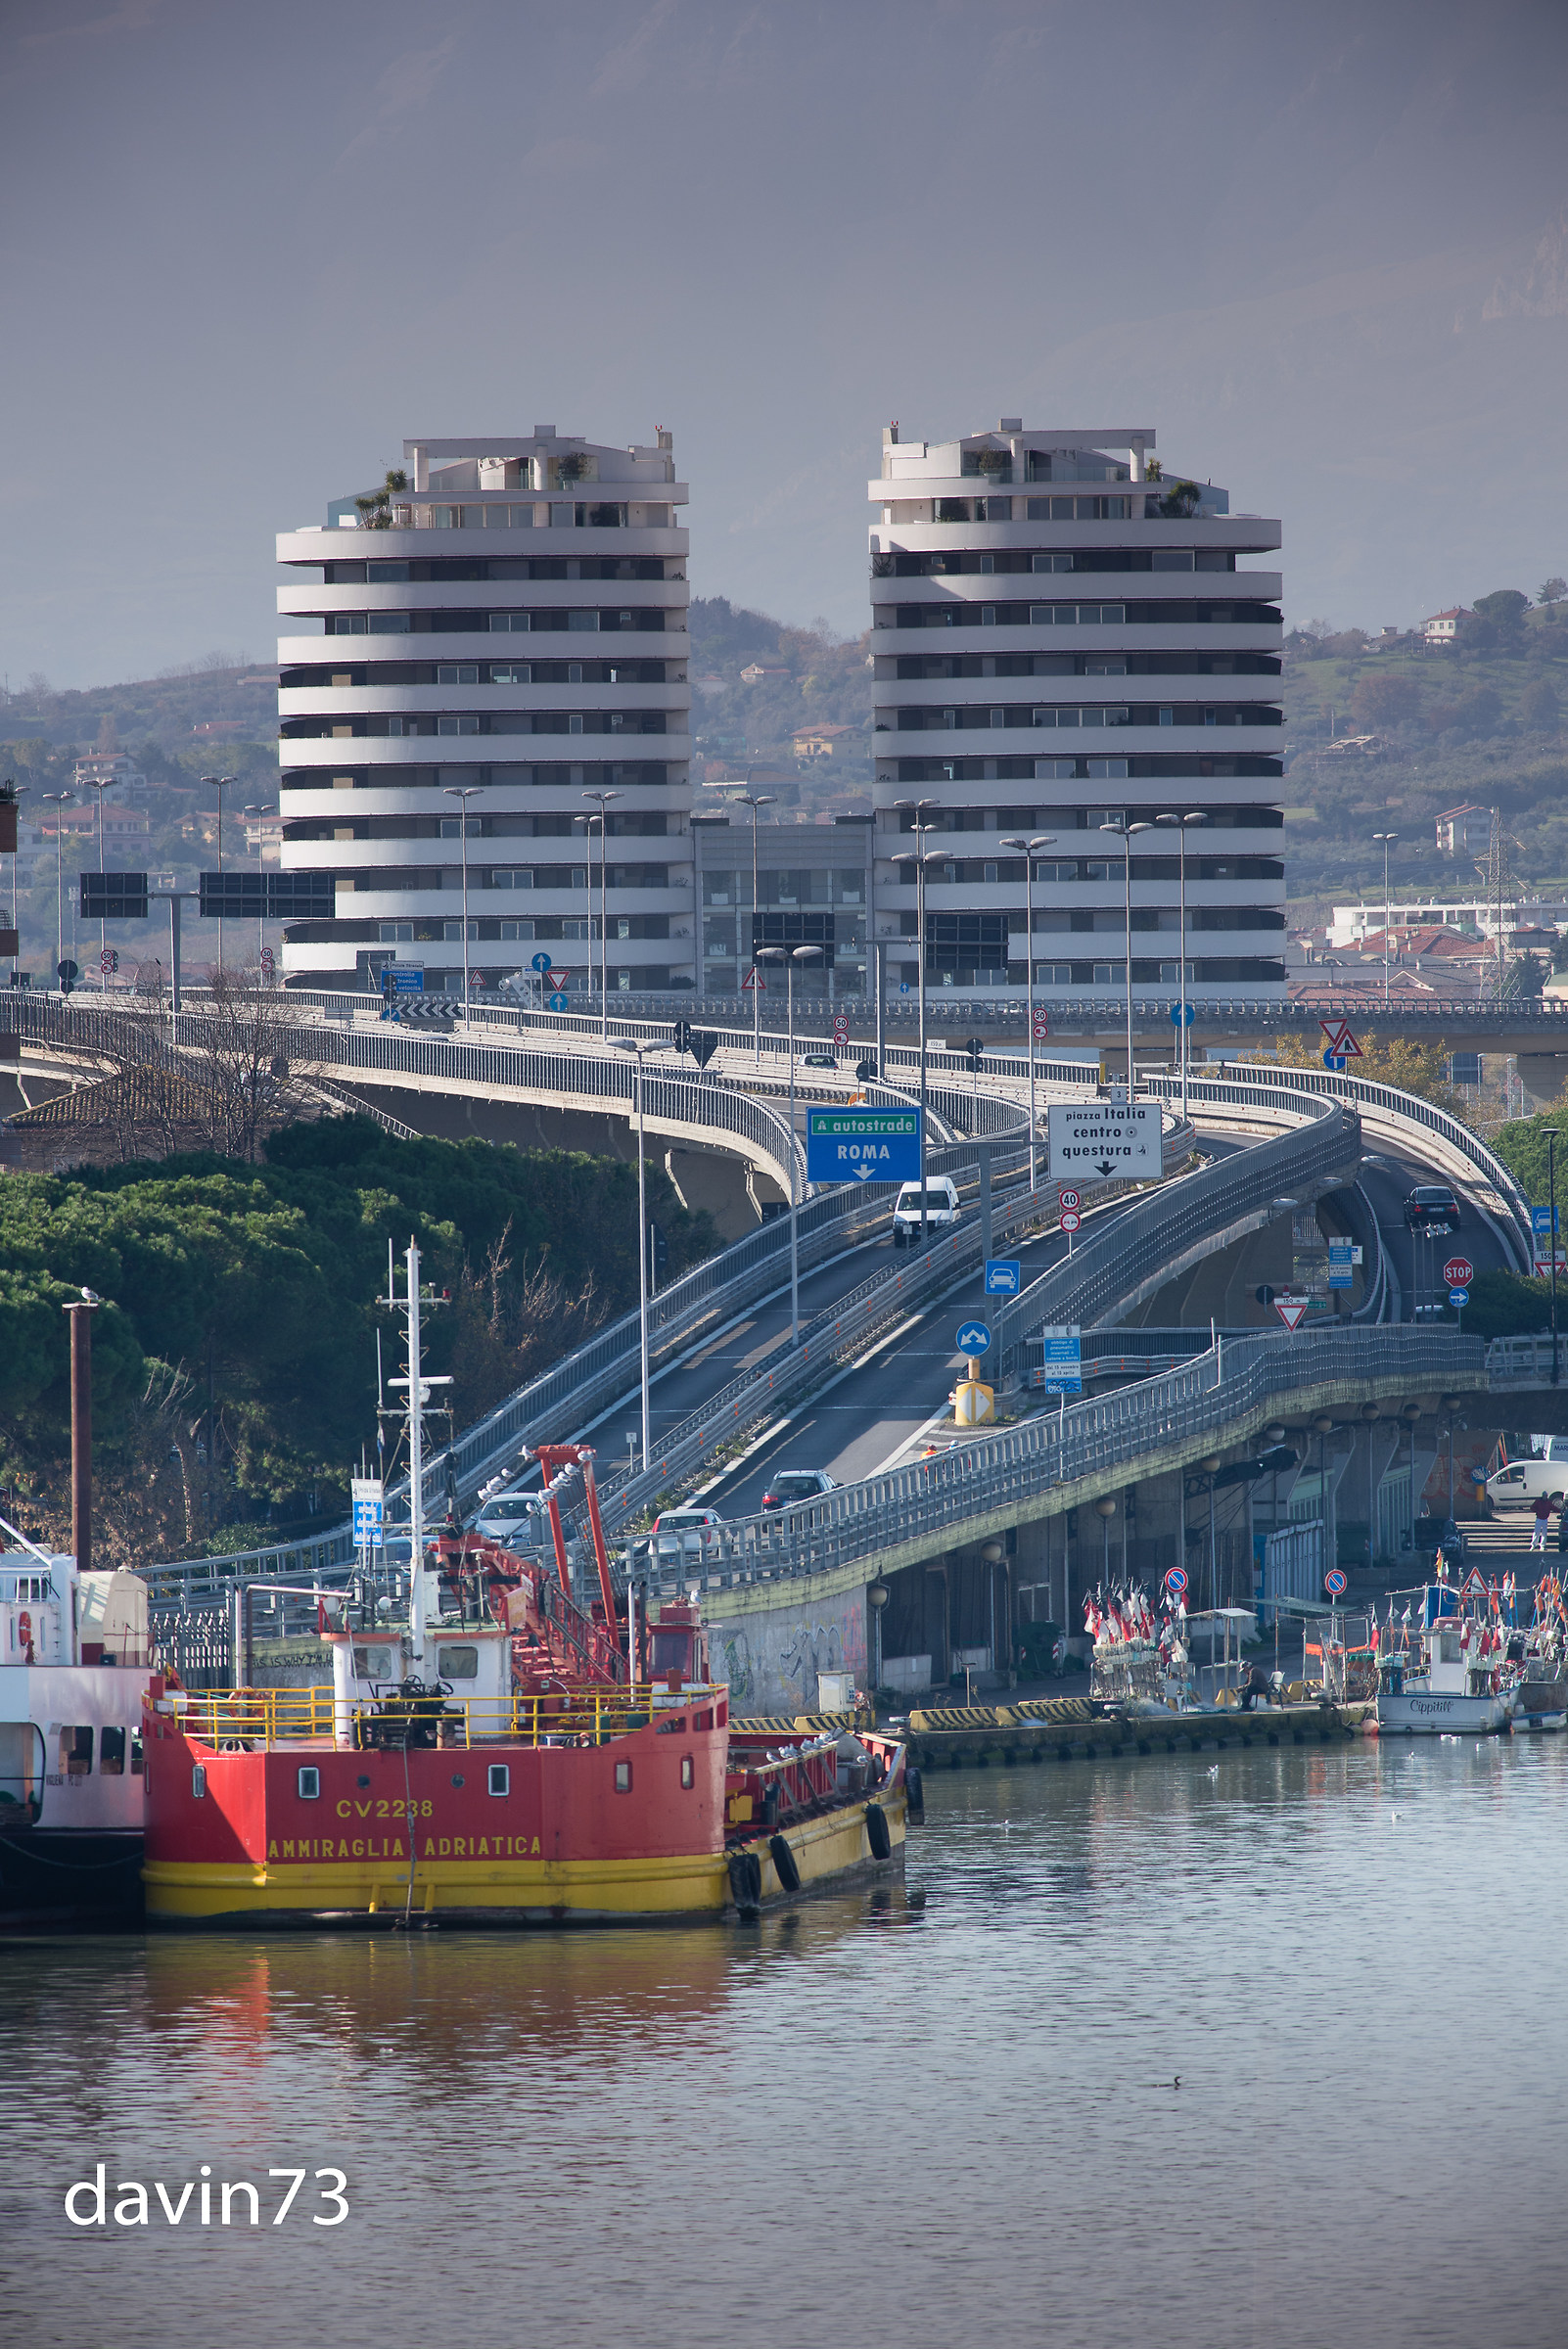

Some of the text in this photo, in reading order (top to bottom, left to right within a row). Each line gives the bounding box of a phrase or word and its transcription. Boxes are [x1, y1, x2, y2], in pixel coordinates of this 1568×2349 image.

[1035, 1011, 1045, 1020] 50
[836, 1019, 847, 1028] 50
[1066, 1107, 1146, 1122] piazza Italia
[833, 1117, 913, 1131] autostrade
[1073, 1127, 1122, 1137] centro
[837, 1144, 891, 1160] ROMA
[1062, 1144, 1131, 1159] questura
[1063, 1194, 1077, 1205] 40
[1446, 1267, 1471, 1278] STOP
[336, 1799, 434, 1819] CV2238
[267, 1835, 541, 1858] AMMIRAGLIA ADRIATICA
